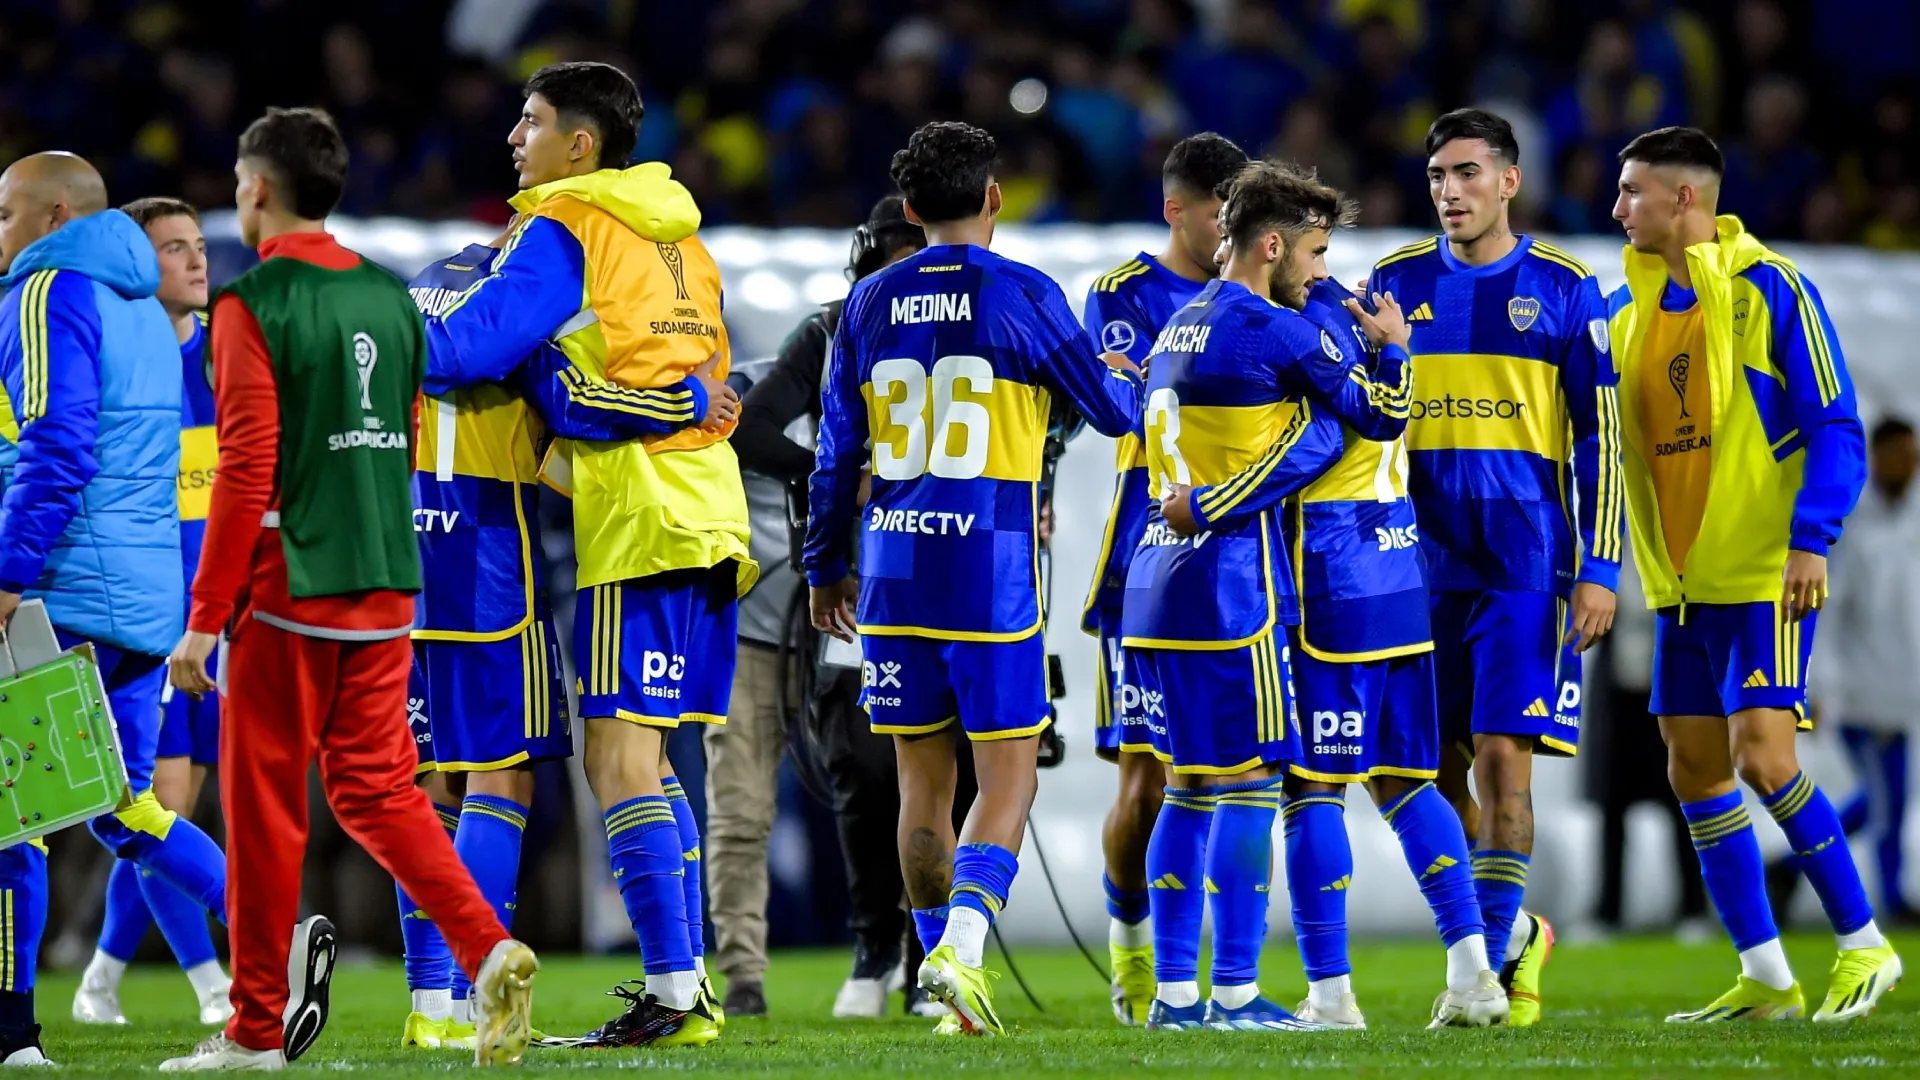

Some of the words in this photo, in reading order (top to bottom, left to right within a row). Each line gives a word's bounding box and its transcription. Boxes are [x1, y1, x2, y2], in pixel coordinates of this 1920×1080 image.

[891, 293, 972, 325] MEDINA
[871, 355, 994, 481] 36
[1148, 387, 1192, 515] 3
[868, 507, 976, 537] DIRECTV
